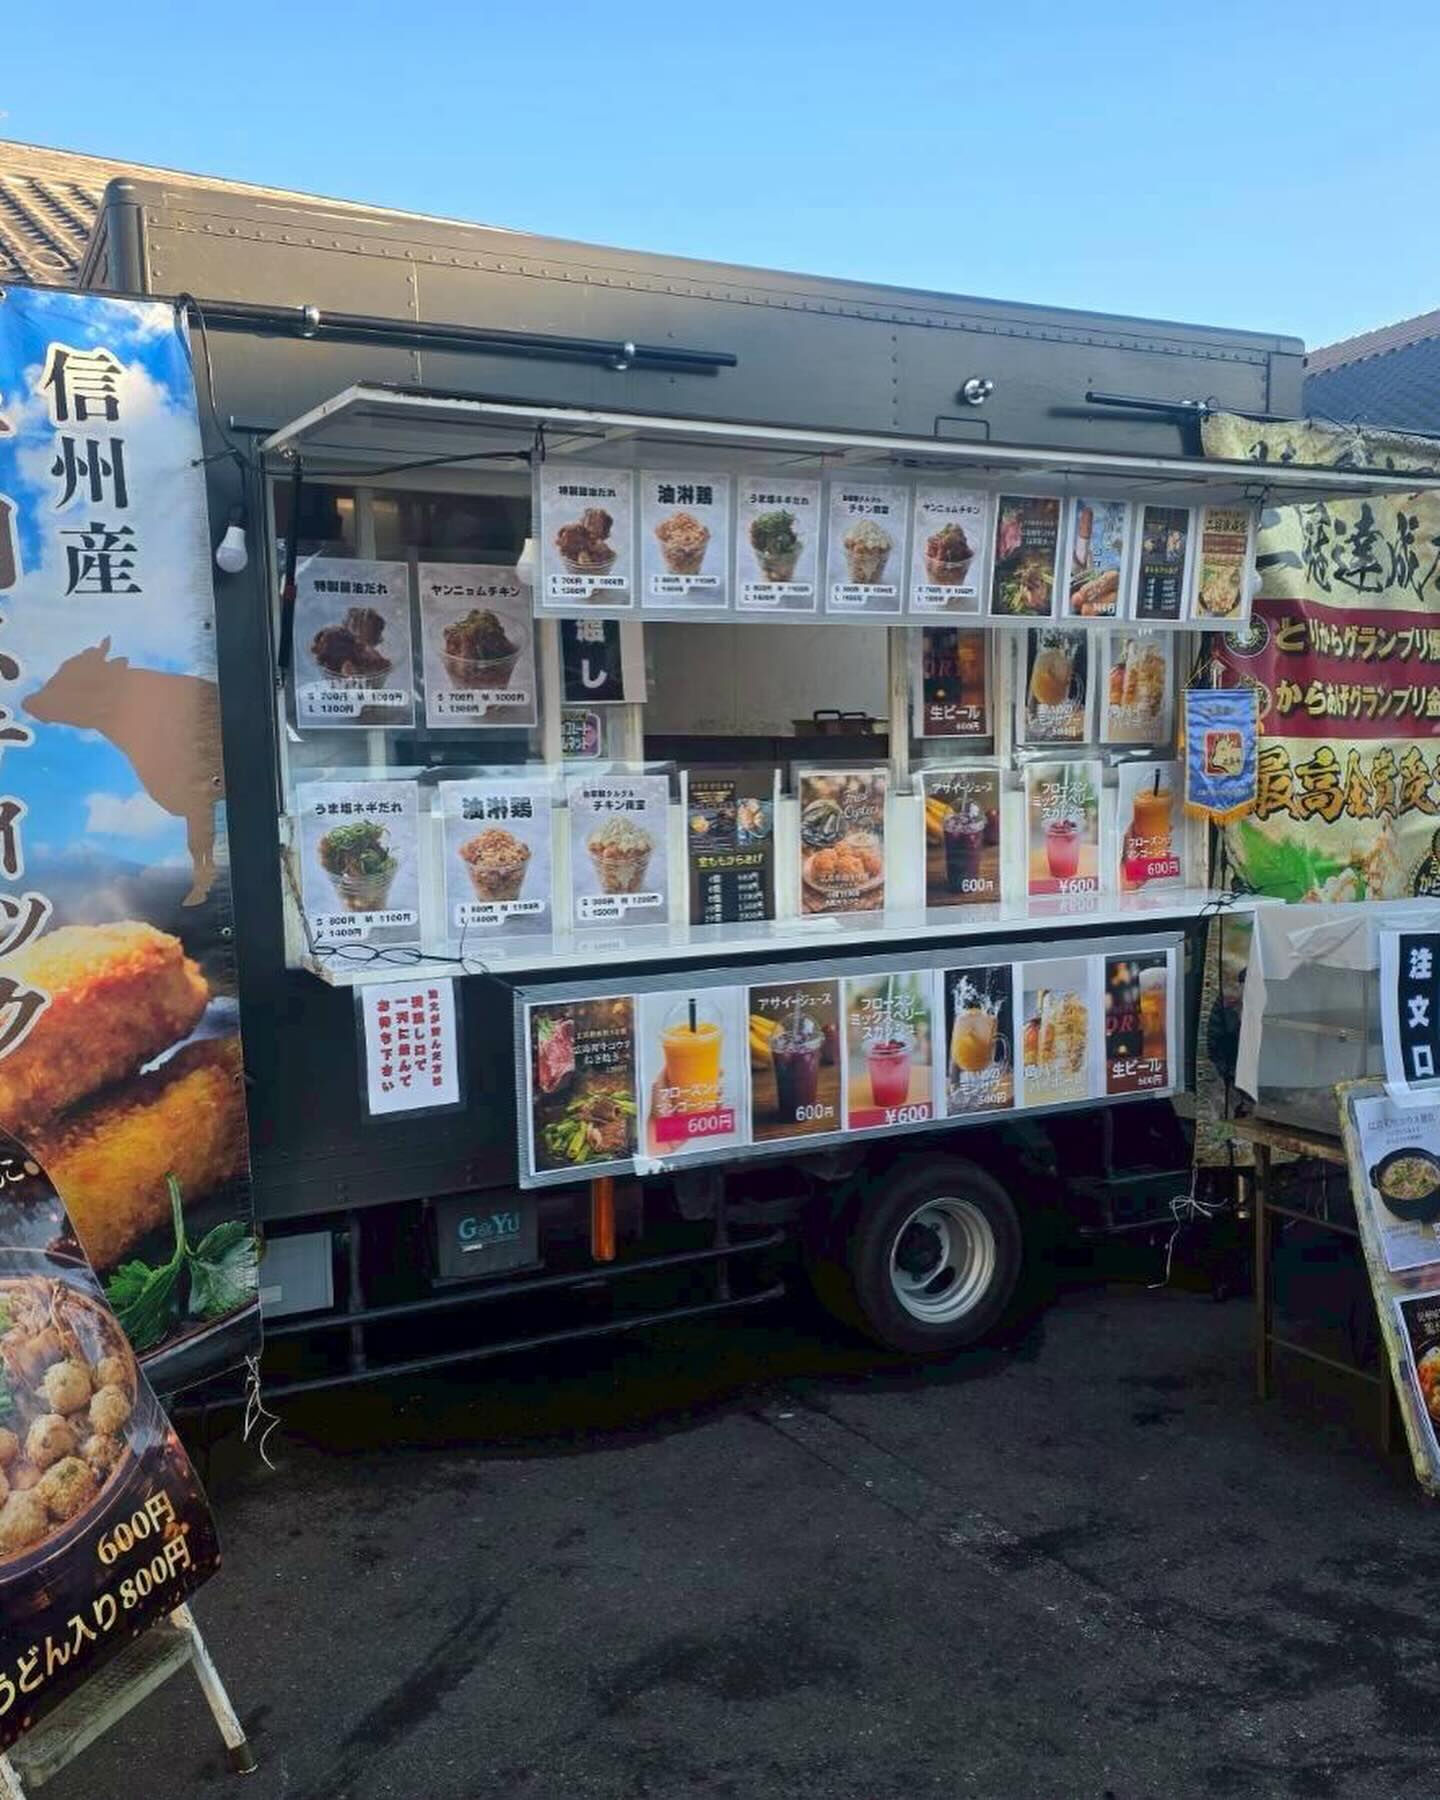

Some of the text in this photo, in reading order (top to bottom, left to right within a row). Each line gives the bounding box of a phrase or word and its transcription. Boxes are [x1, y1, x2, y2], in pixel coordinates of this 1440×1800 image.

[43, 348, 144, 597] 信州産
[657, 484, 714, 506] 油淋鶏
[314, 580, 388, 595] 特製醤油だれ
[432, 585, 521, 598] ヤンニョムチキン
[930, 704, 981, 721] 生ビール
[1256, 745, 1440, 824] 最高金賞受
[315, 801, 403, 815] うま塩ネギだれ
[462, 797, 533, 820] 油淋鶏
[1147, 861, 1179, 876] 600円
[961, 878, 995, 893] 600円
[1059, 879, 1096, 895] ¥600
[757, 992, 833, 1010] アサイージュース
[861, 993, 917, 1011] フローズン
[850, 1009, 927, 1026] ミックスベリー
[1408, 947, 1435, 1077] 注文口
[1111, 1057, 1162, 1079] 生ビール
[796, 1104, 834, 1121] 600円
[885, 1104, 929, 1125] ¥600
[687, 1113, 733, 1133] 600円
[97, 1489, 176, 1565] 600円
[0, 1535, 192, 1716] うどん入り800円
